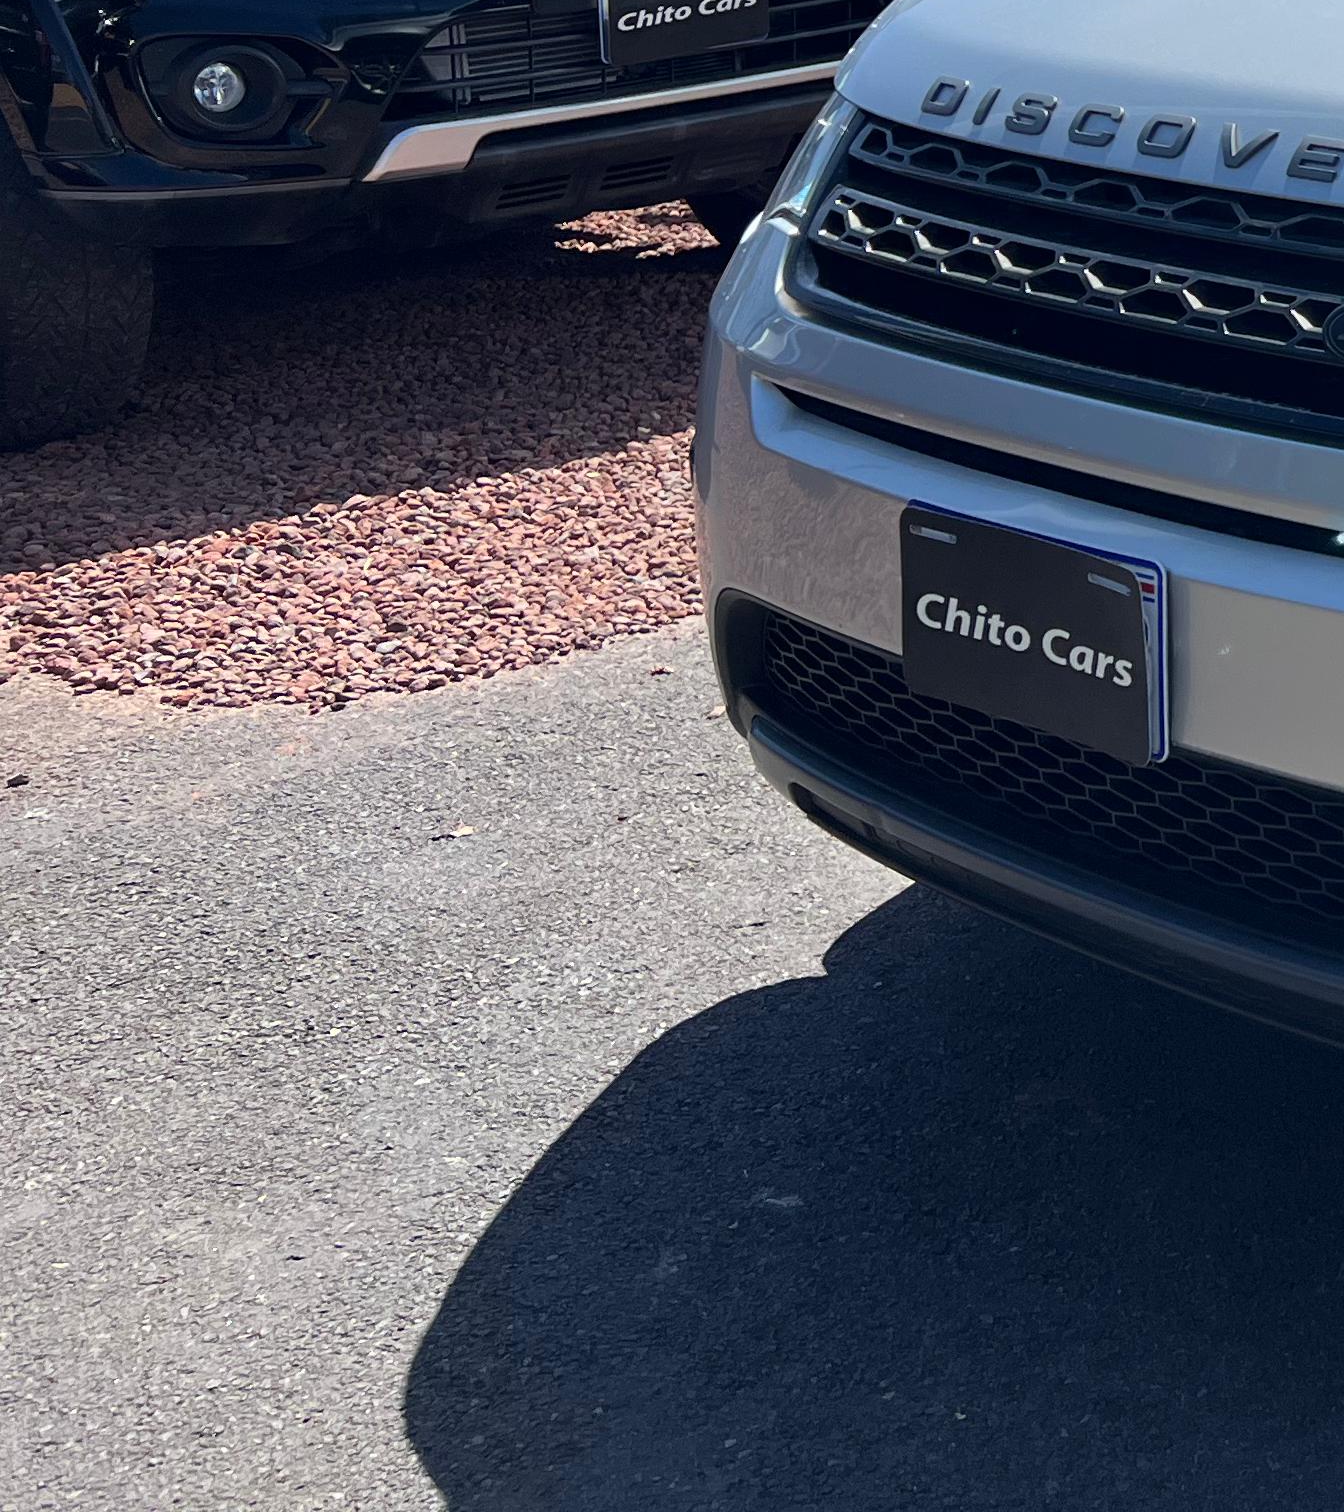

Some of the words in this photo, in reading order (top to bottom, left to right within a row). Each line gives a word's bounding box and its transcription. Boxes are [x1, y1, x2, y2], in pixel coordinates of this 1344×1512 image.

[617, 5, 692, 31] Chito
[916, 593, 1031, 652] Chito
[1042, 629, 1132, 687] Cars
